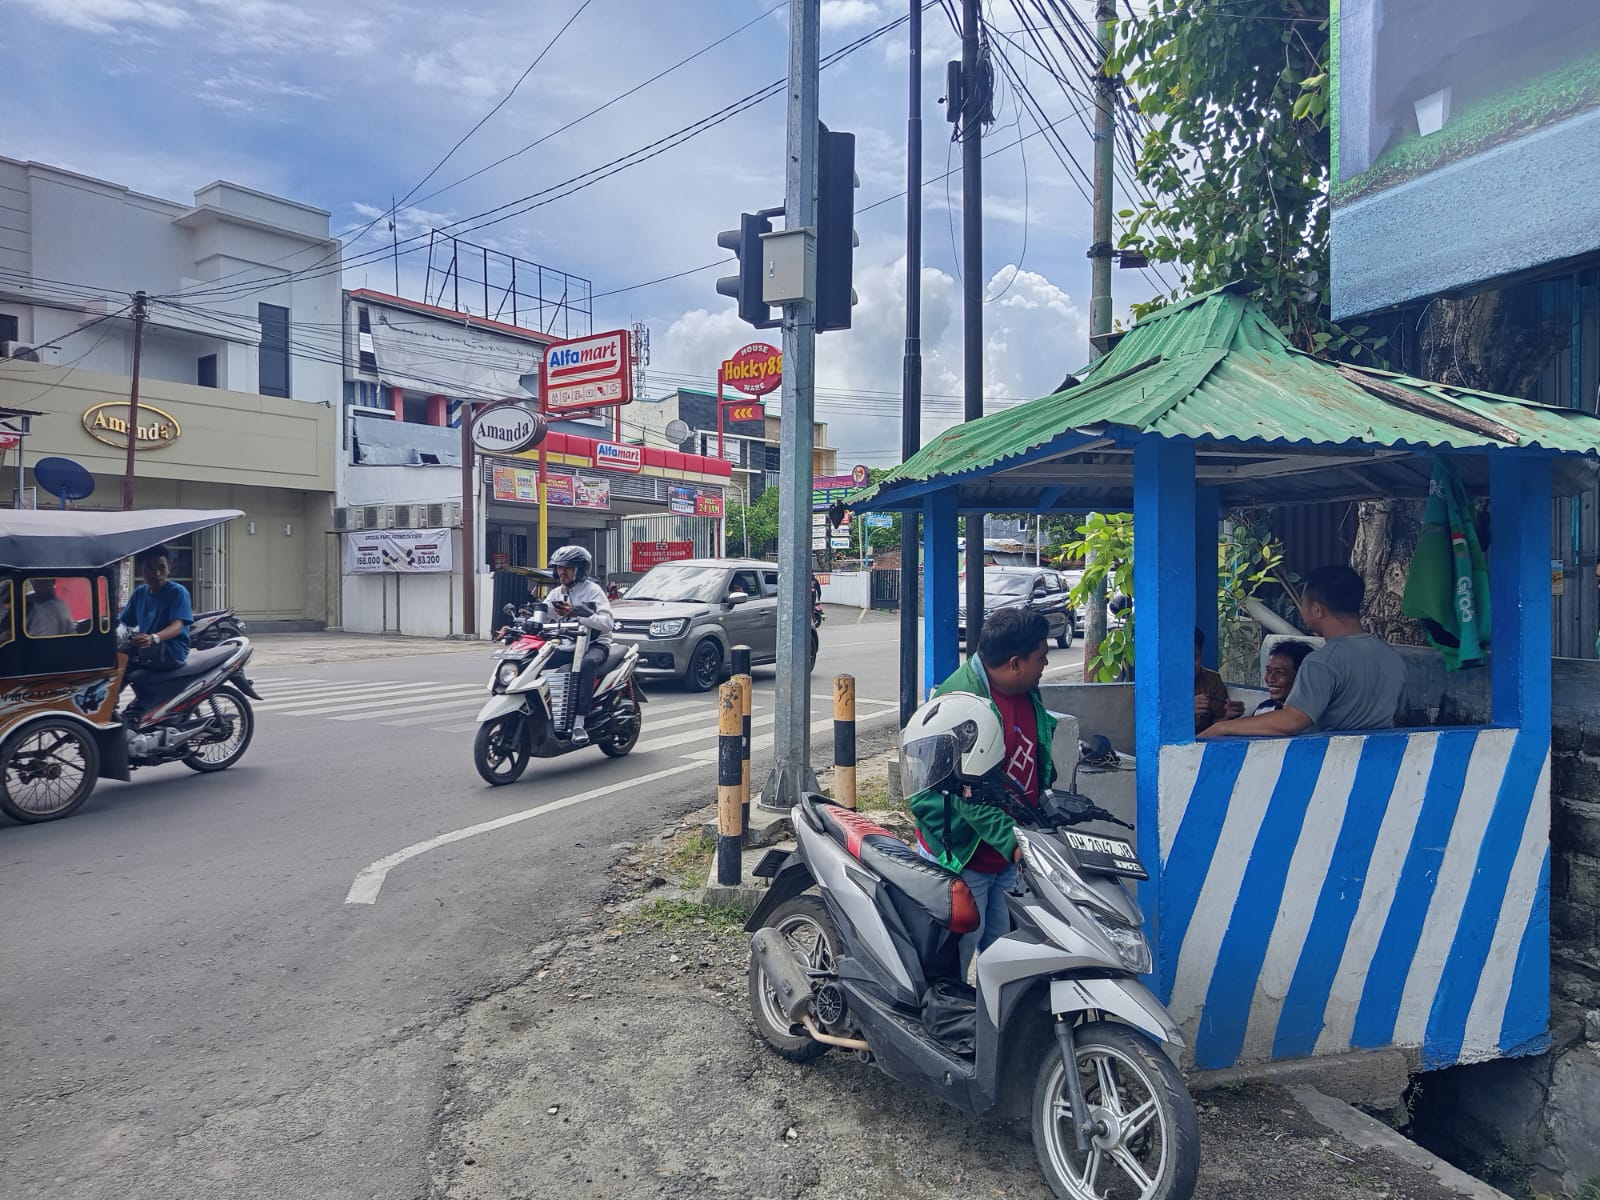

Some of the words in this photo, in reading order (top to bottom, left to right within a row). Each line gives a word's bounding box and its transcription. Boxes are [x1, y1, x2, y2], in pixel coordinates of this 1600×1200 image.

[549, 341, 617, 368] Alfamart
[740, 344, 769, 356] HOUSE
[91, 409, 170, 440] Amnda
[476, 420, 530, 442] Amanda
[598, 444, 640, 461] Alfamart
